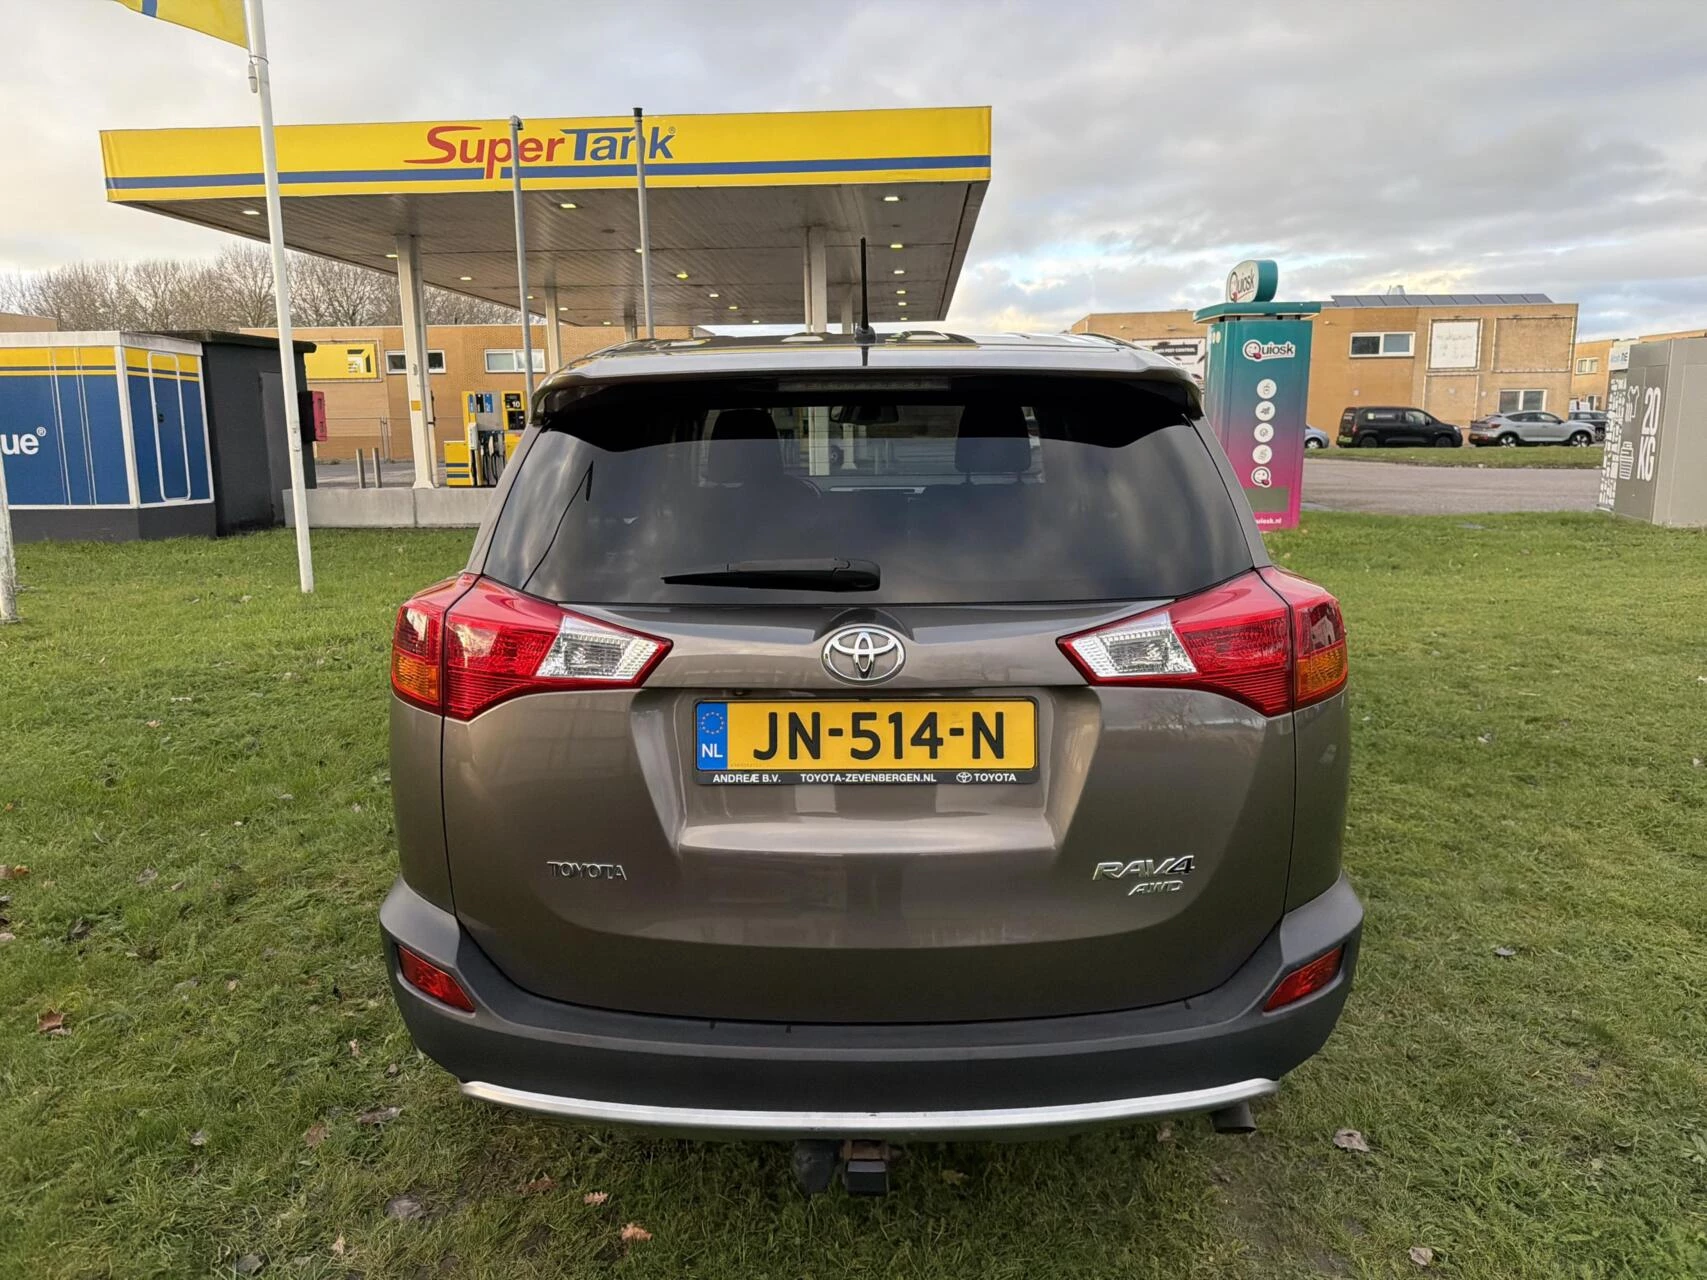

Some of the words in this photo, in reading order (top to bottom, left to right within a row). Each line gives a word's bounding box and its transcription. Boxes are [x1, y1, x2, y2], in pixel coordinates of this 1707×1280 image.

[1230, 267, 1255, 302] Quiosk
[1244, 341, 1294, 359] Quiosk
[1641, 387, 1661, 436] 20
[1637, 436, 1656, 482] KG
[753, 711, 1004, 761] JN-514-N
[701, 743, 723, 758] NL
[763, 773, 781, 783] B.V.
[800, 773, 937, 783] TOYOTA-ZEVENBERGEN.NL
[974, 773, 1017, 782] TOYOTA
[546, 861, 627, 880] TOYOTA
[1092, 855, 1195, 880] RAV4
[1128, 880, 1183, 896] AWD
